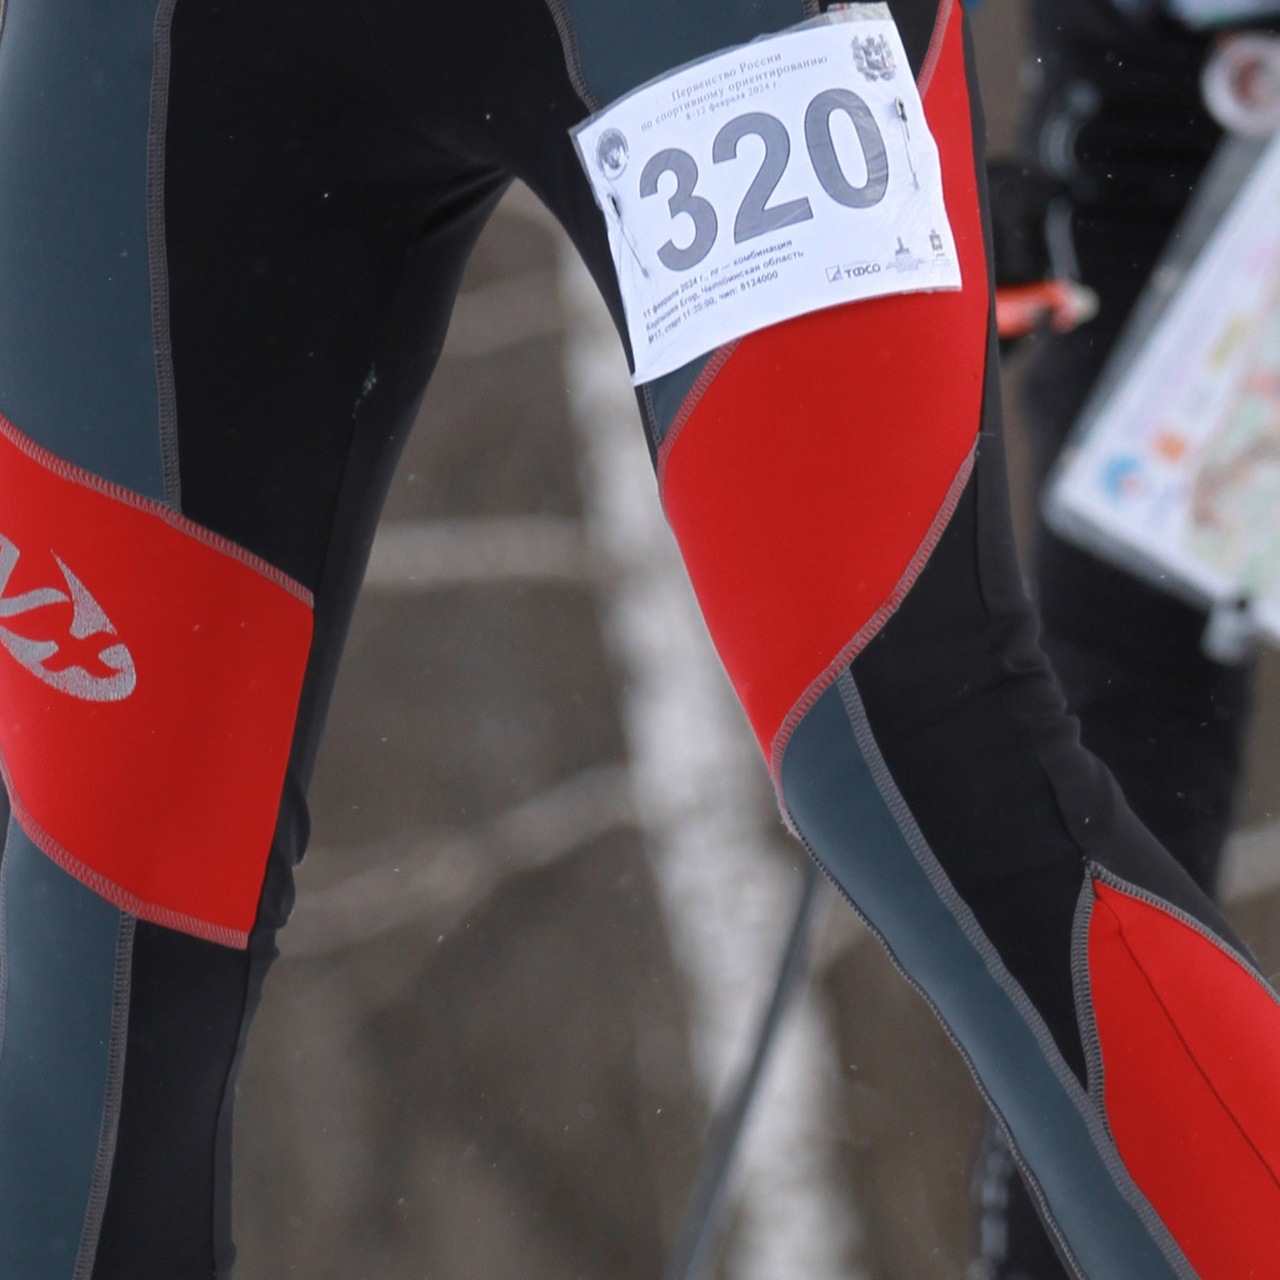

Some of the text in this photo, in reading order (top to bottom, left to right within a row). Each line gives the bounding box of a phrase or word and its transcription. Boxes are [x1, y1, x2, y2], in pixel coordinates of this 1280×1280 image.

[640, 55, 829, 133] по спортивному ориентированию
[671, 52, 782, 101] Первенство России
[708, 92, 746, 113] февраля
[747, 83, 771, 97] 2024
[639, 87, 889, 272] 320
[701, 265, 762, 293] Челябинская
[763, 252, 804, 269] область
[733, 239, 793, 267] комбинация
